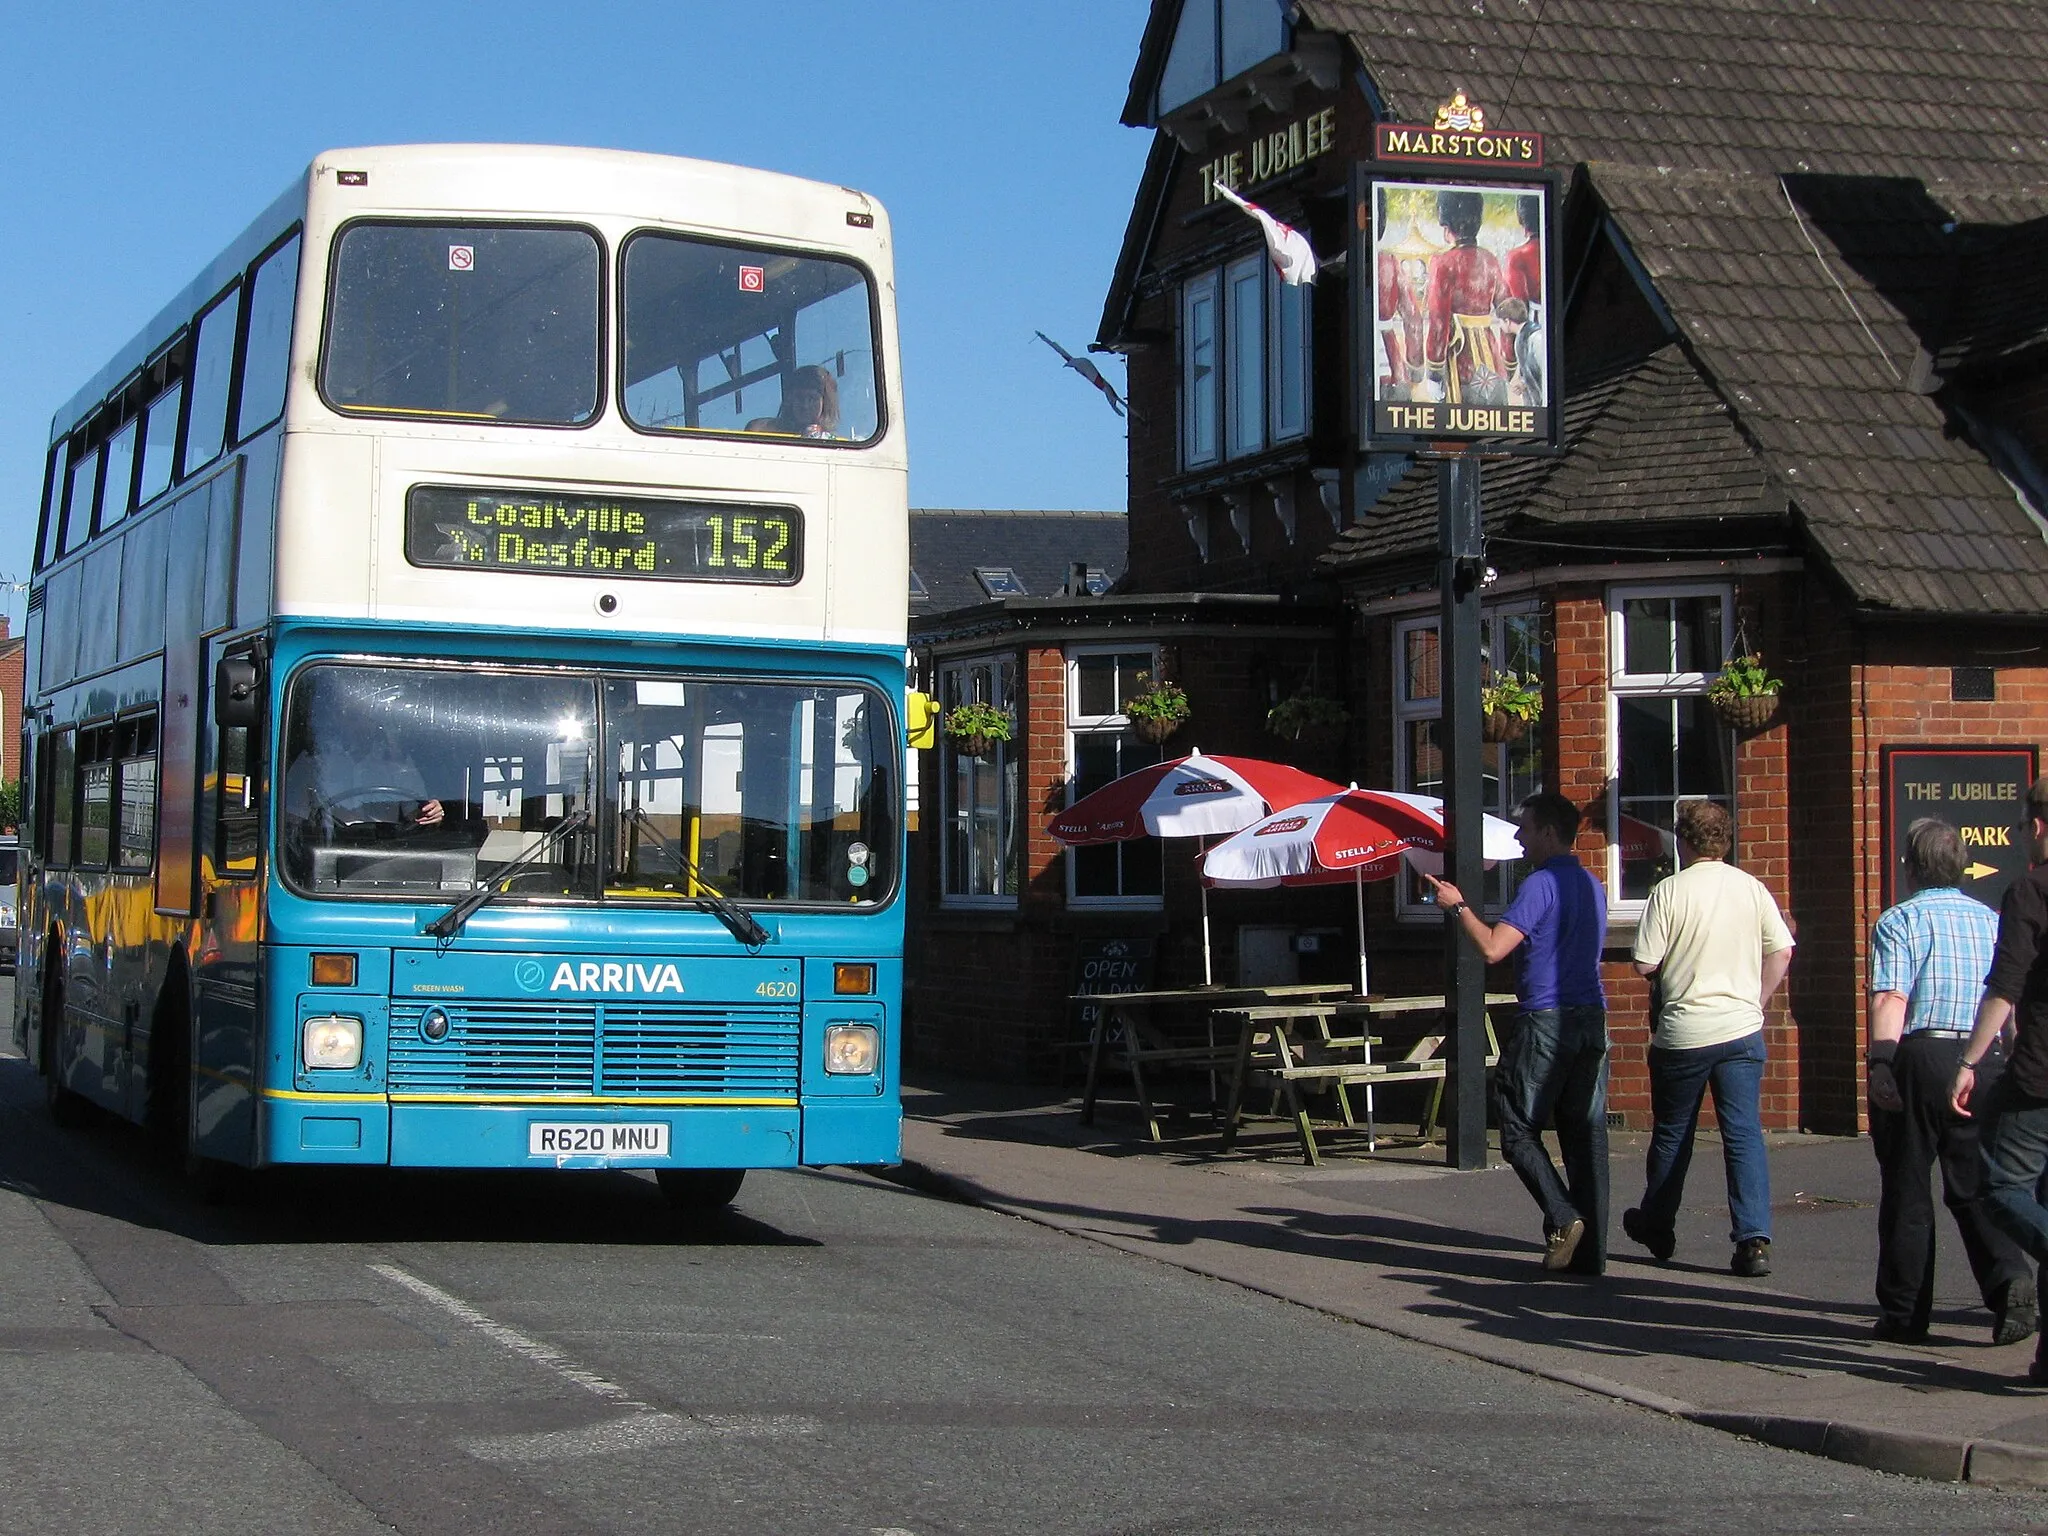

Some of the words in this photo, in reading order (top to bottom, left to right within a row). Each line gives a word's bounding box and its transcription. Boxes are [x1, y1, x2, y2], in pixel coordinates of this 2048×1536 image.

[1199, 151, 1243, 205] THE
[1248, 106, 1336, 185] JUBILEE
[1388, 131, 1534, 160] MARSTON'S
[1387, 406, 1435, 431] THE
[1446, 408, 1535, 433] JUBILEE
[498, 533, 656, 572] Desford
[705, 515, 790, 571] 152
[1904, 782, 1941, 801] THE
[1948, 782, 2018, 801] JUBILEE
[1058, 824, 1088, 833] STELLA
[1961, 826, 2012, 846] PARK
[1335, 845, 1375, 859] STELLA
[1396, 836, 1434, 847] ARTOIS
[550, 962, 685, 994] ARRIVA
[1083, 959, 1138, 978] OPEN
[413, 984, 440, 992] SCREEN
[441, 985, 465, 993] WASH
[755, 981, 798, 998] 4620
[541, 1128, 605, 1151] R620
[612, 1127, 659, 1150] MNU
